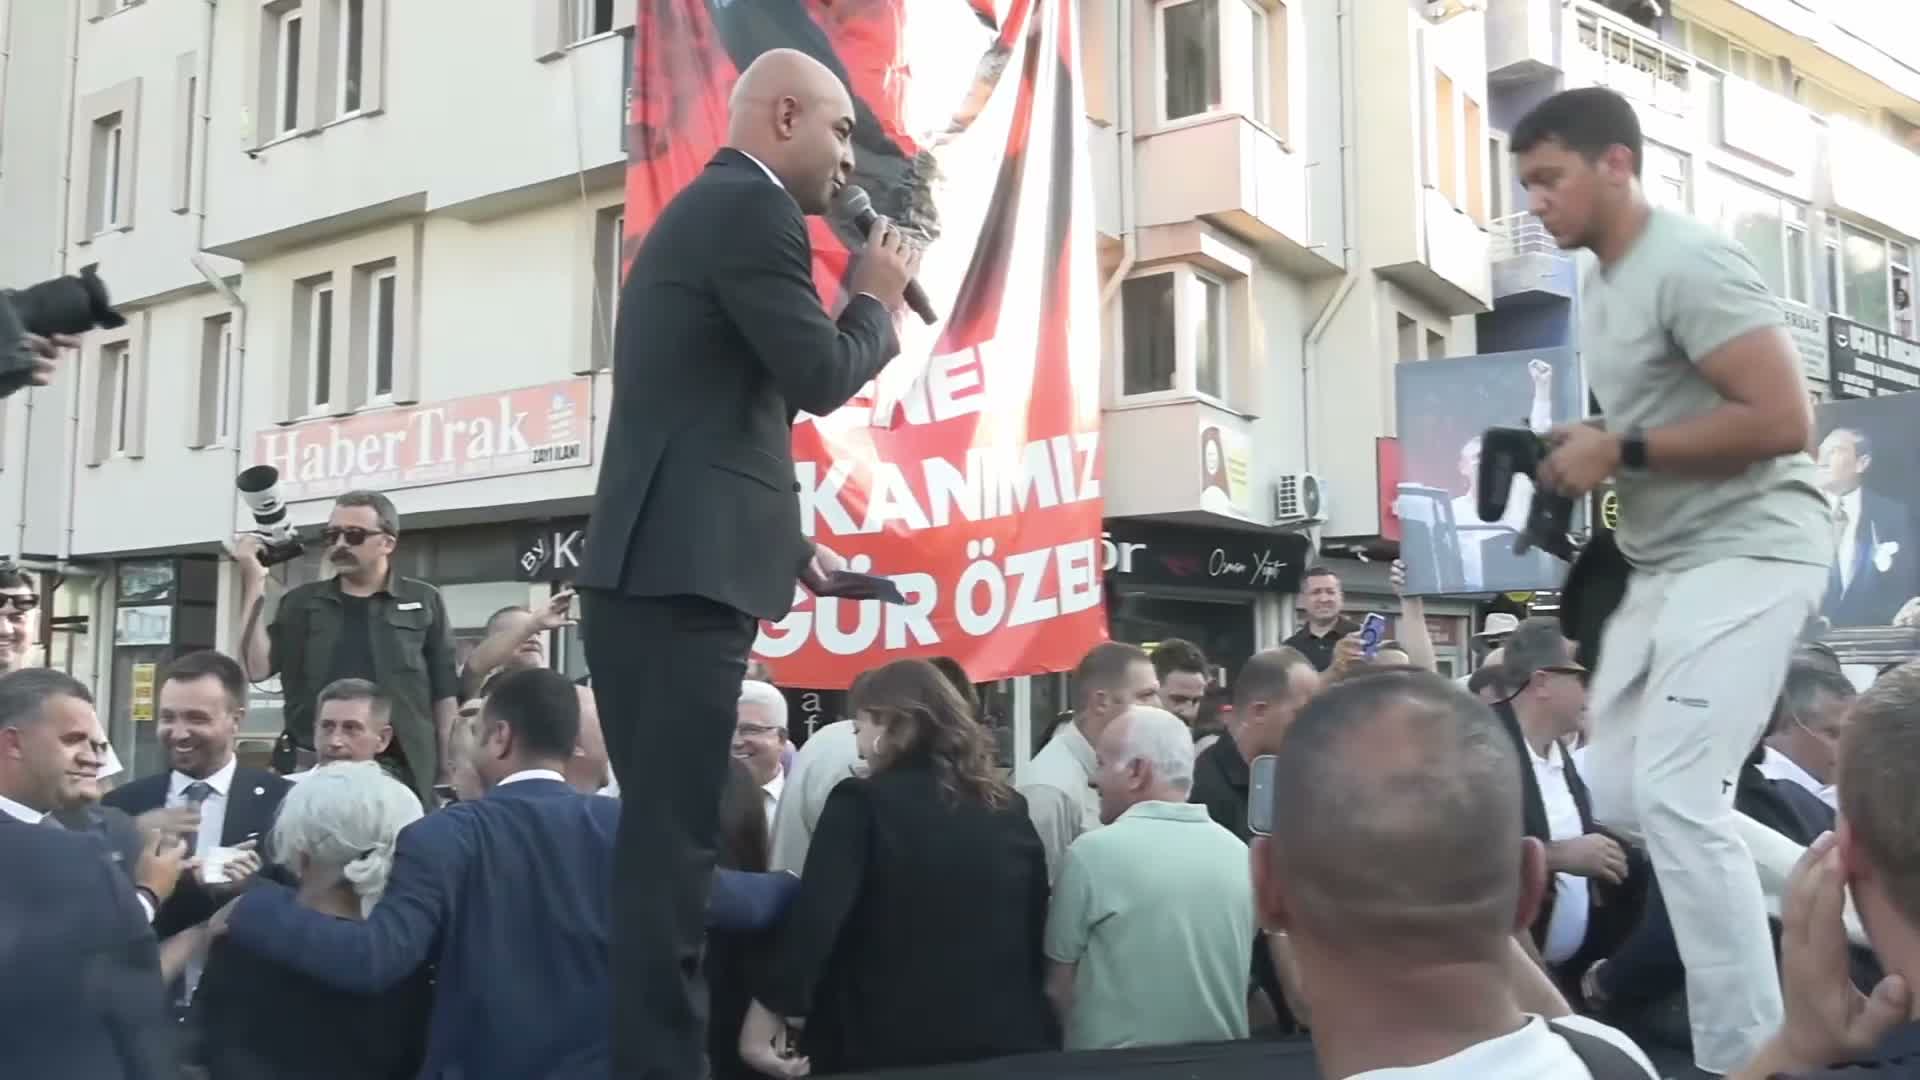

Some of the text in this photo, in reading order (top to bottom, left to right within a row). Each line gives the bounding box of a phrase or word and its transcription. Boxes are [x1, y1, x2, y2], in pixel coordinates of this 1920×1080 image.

[262, 425, 408, 484] Haber
[409, 396, 530, 467] Trak
[554, 530, 585, 568] K
[954, 537, 1102, 637] ÖZEL
